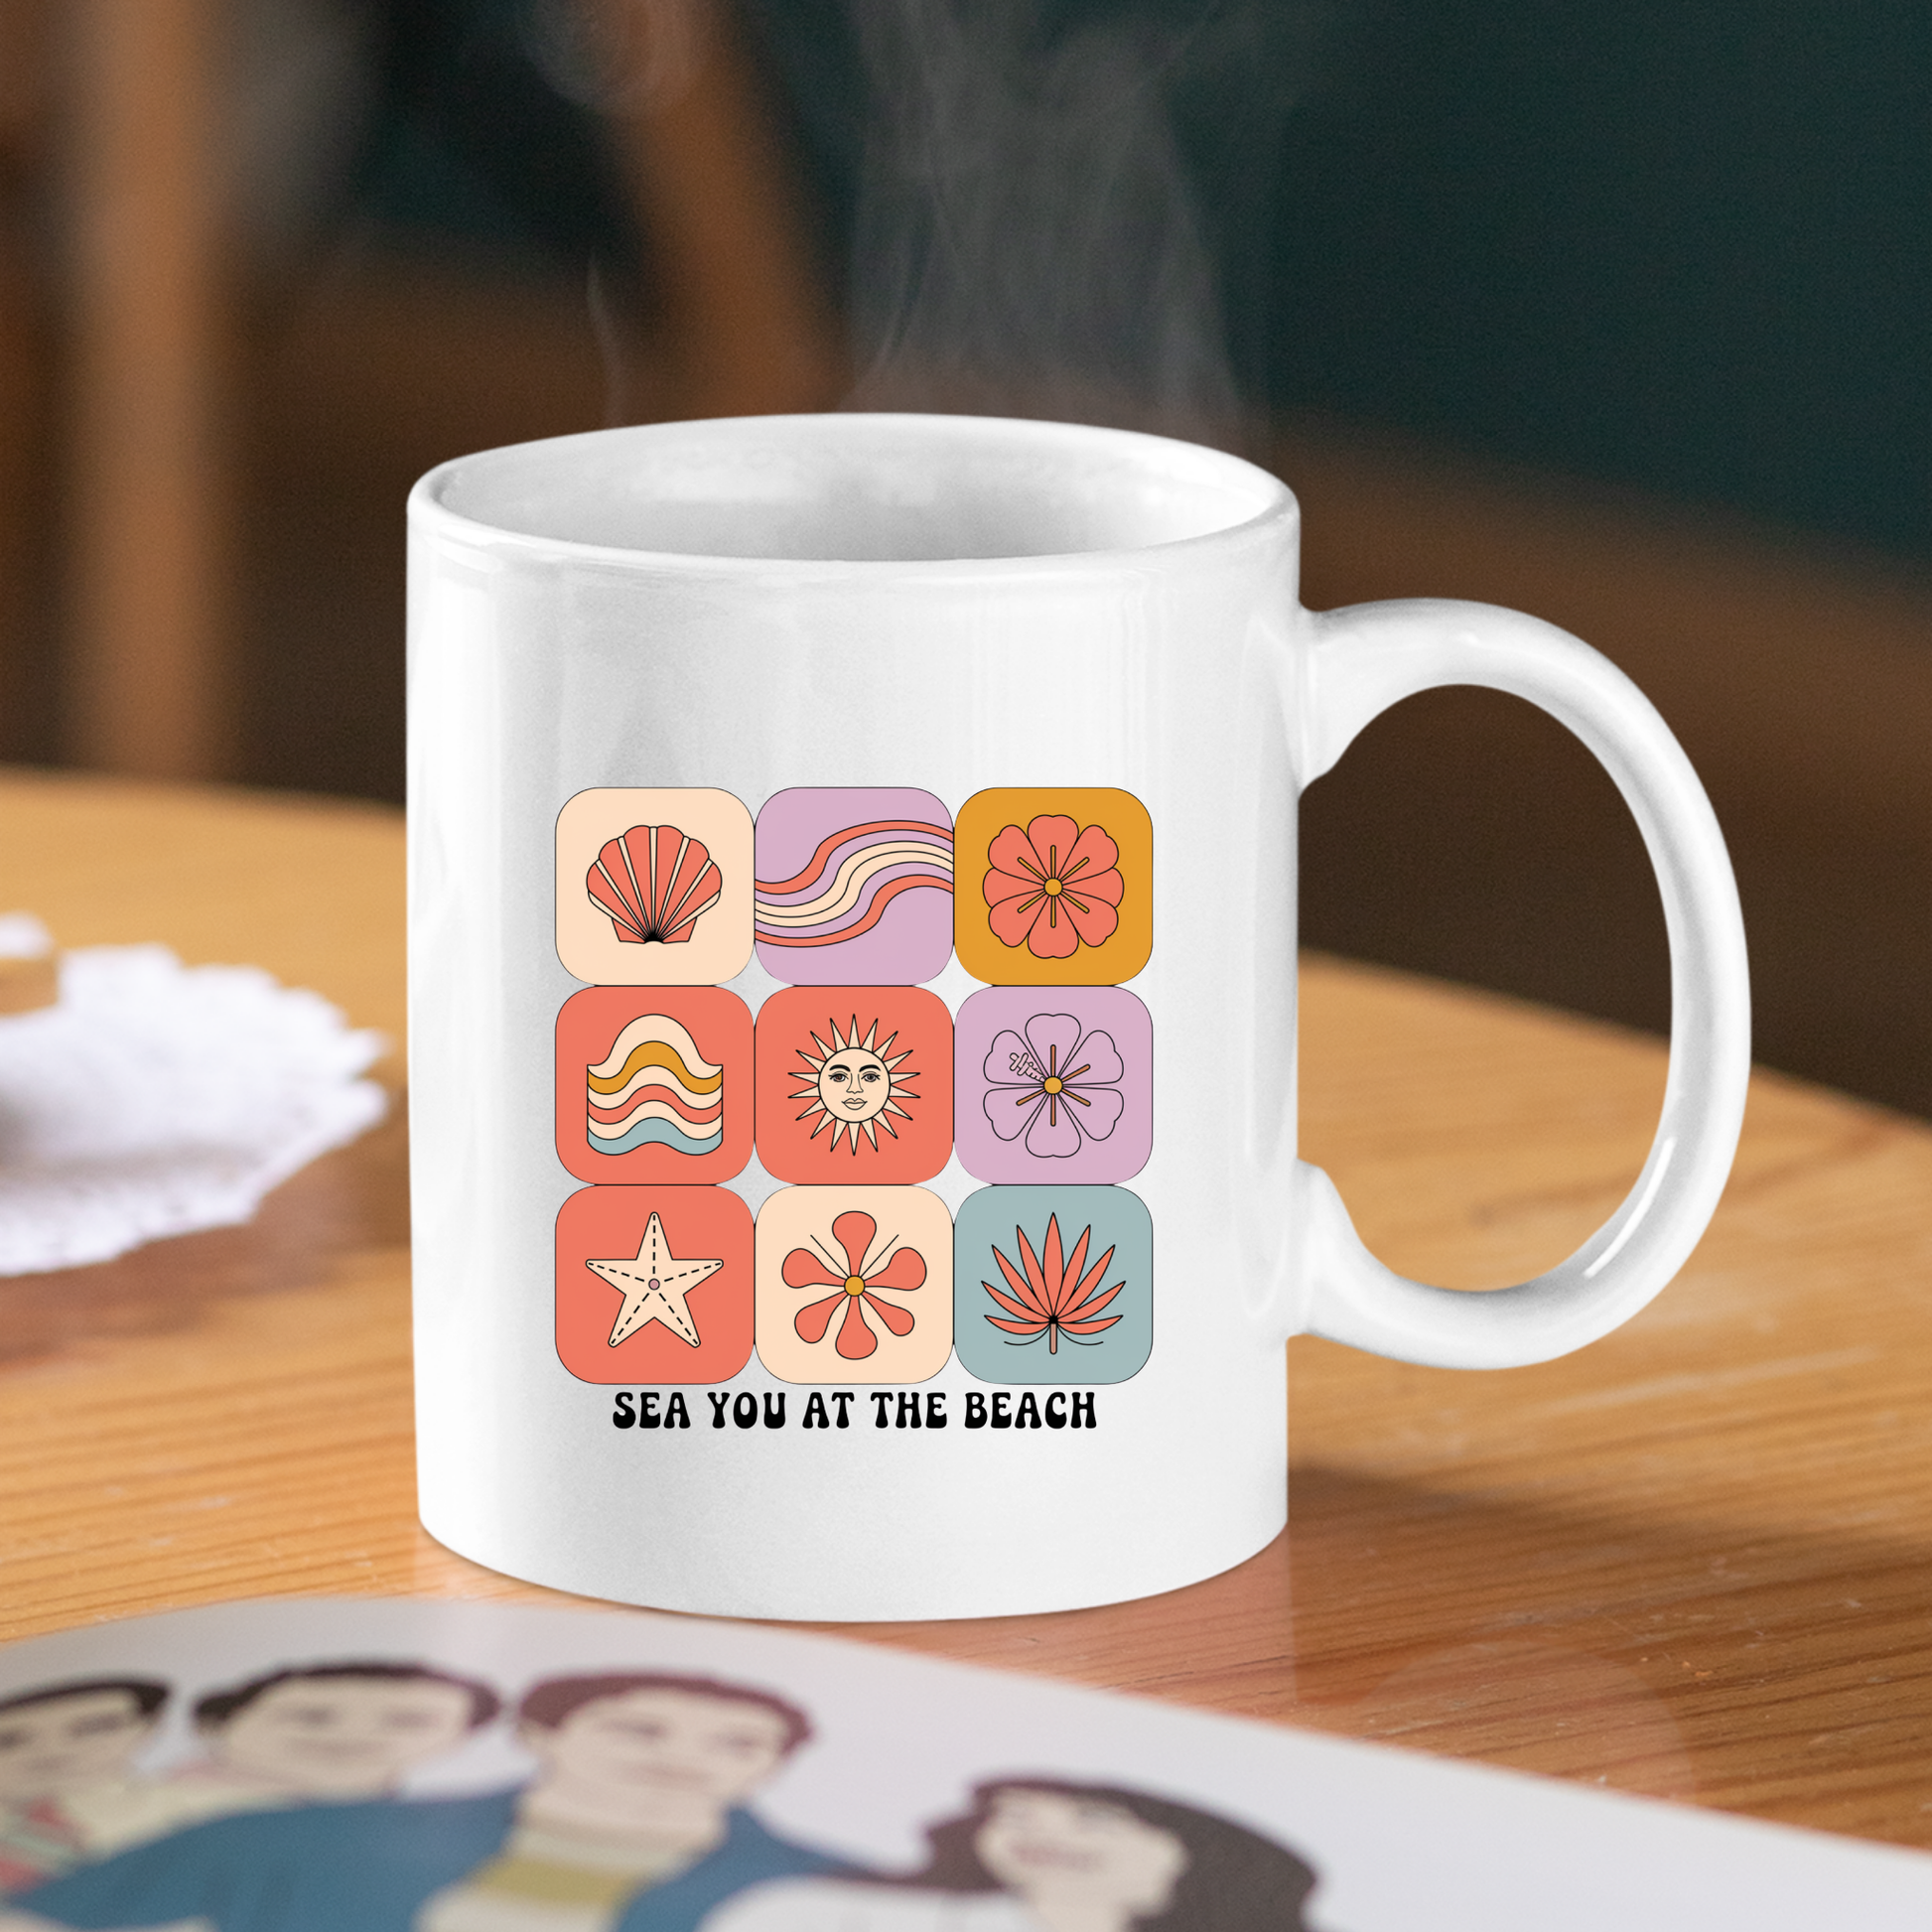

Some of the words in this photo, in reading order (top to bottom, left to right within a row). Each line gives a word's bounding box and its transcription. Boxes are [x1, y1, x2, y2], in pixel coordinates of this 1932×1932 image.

[612, 1391, 691, 1430] SEA
[707, 1391, 786, 1430] YOU
[801, 1391, 855, 1430] AT
[870, 1391, 948, 1430] THE
[964, 1391, 1097, 1430] BEACH
